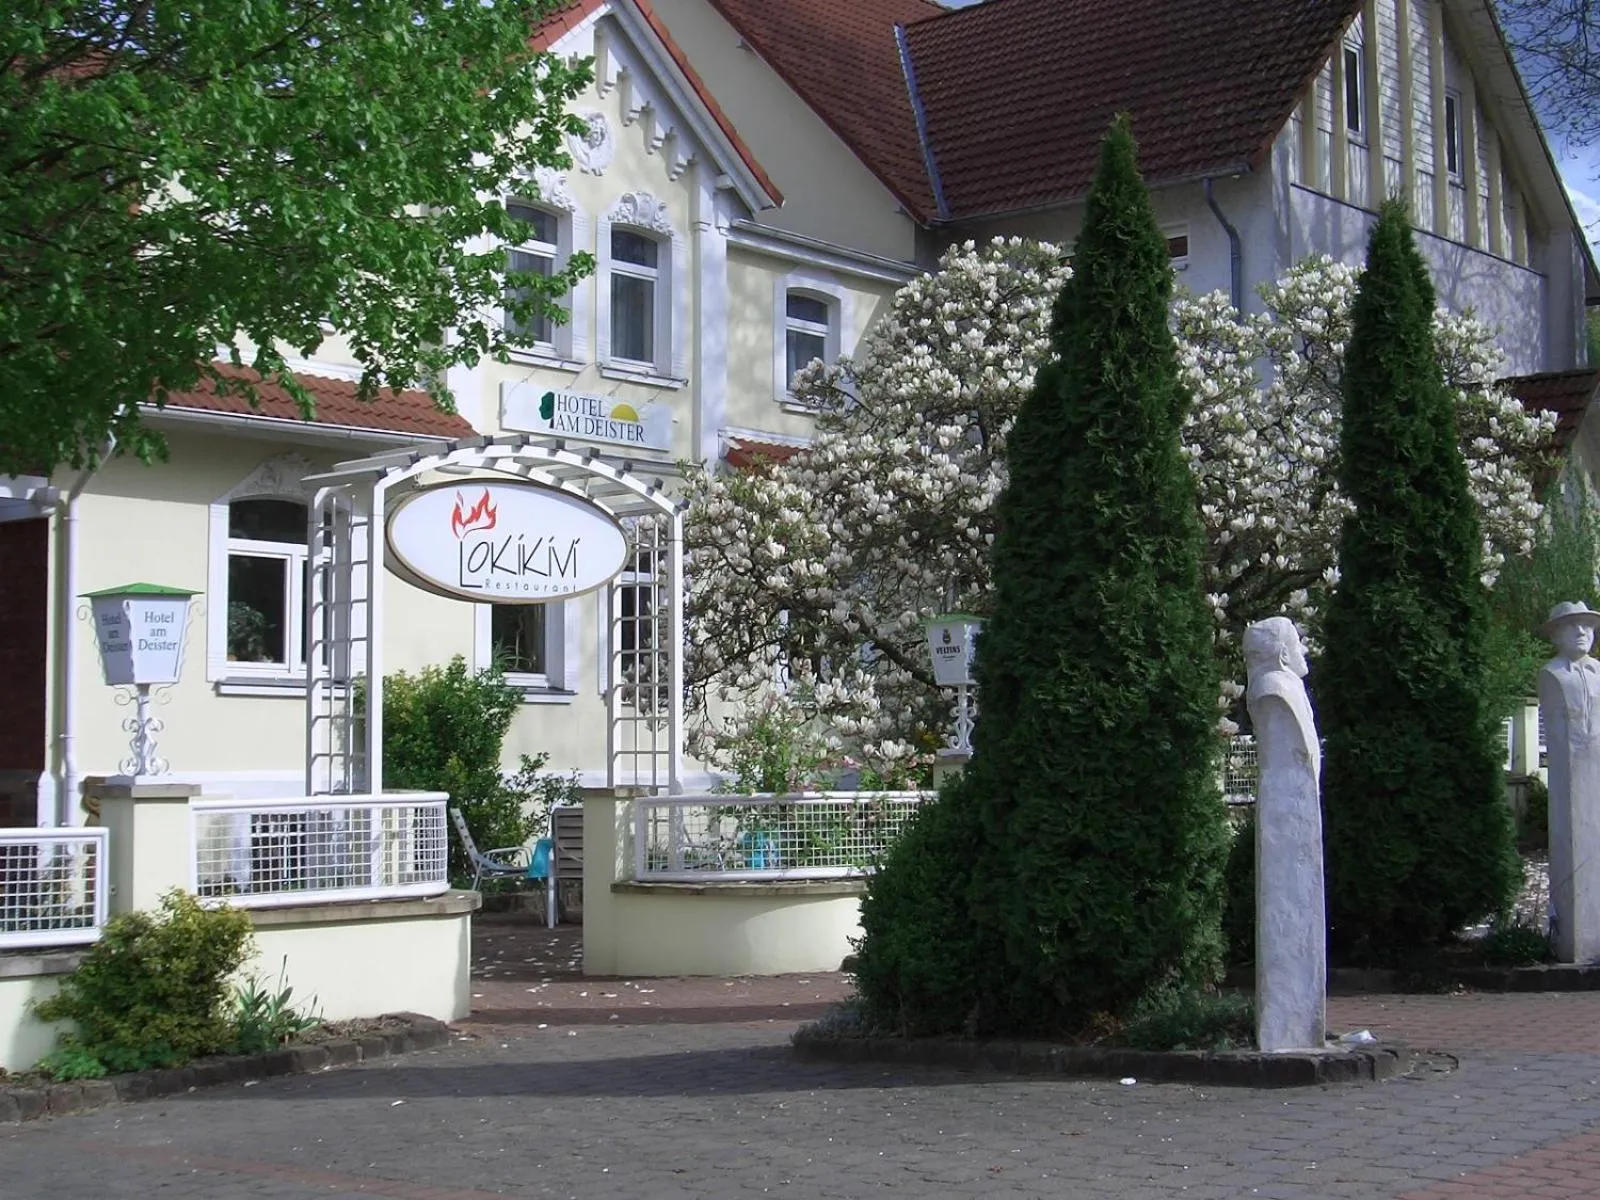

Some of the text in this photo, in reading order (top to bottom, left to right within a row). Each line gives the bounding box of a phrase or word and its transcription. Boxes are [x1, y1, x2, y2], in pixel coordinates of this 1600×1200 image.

[557, 394, 606, 418] HOTEL
[556, 414, 645, 442] AM DEISTER
[484, 579, 577, 592] Restaurant
[144, 611, 174, 623] Hotel
[150, 628, 167, 637] am
[138, 639, 178, 651] Deister
